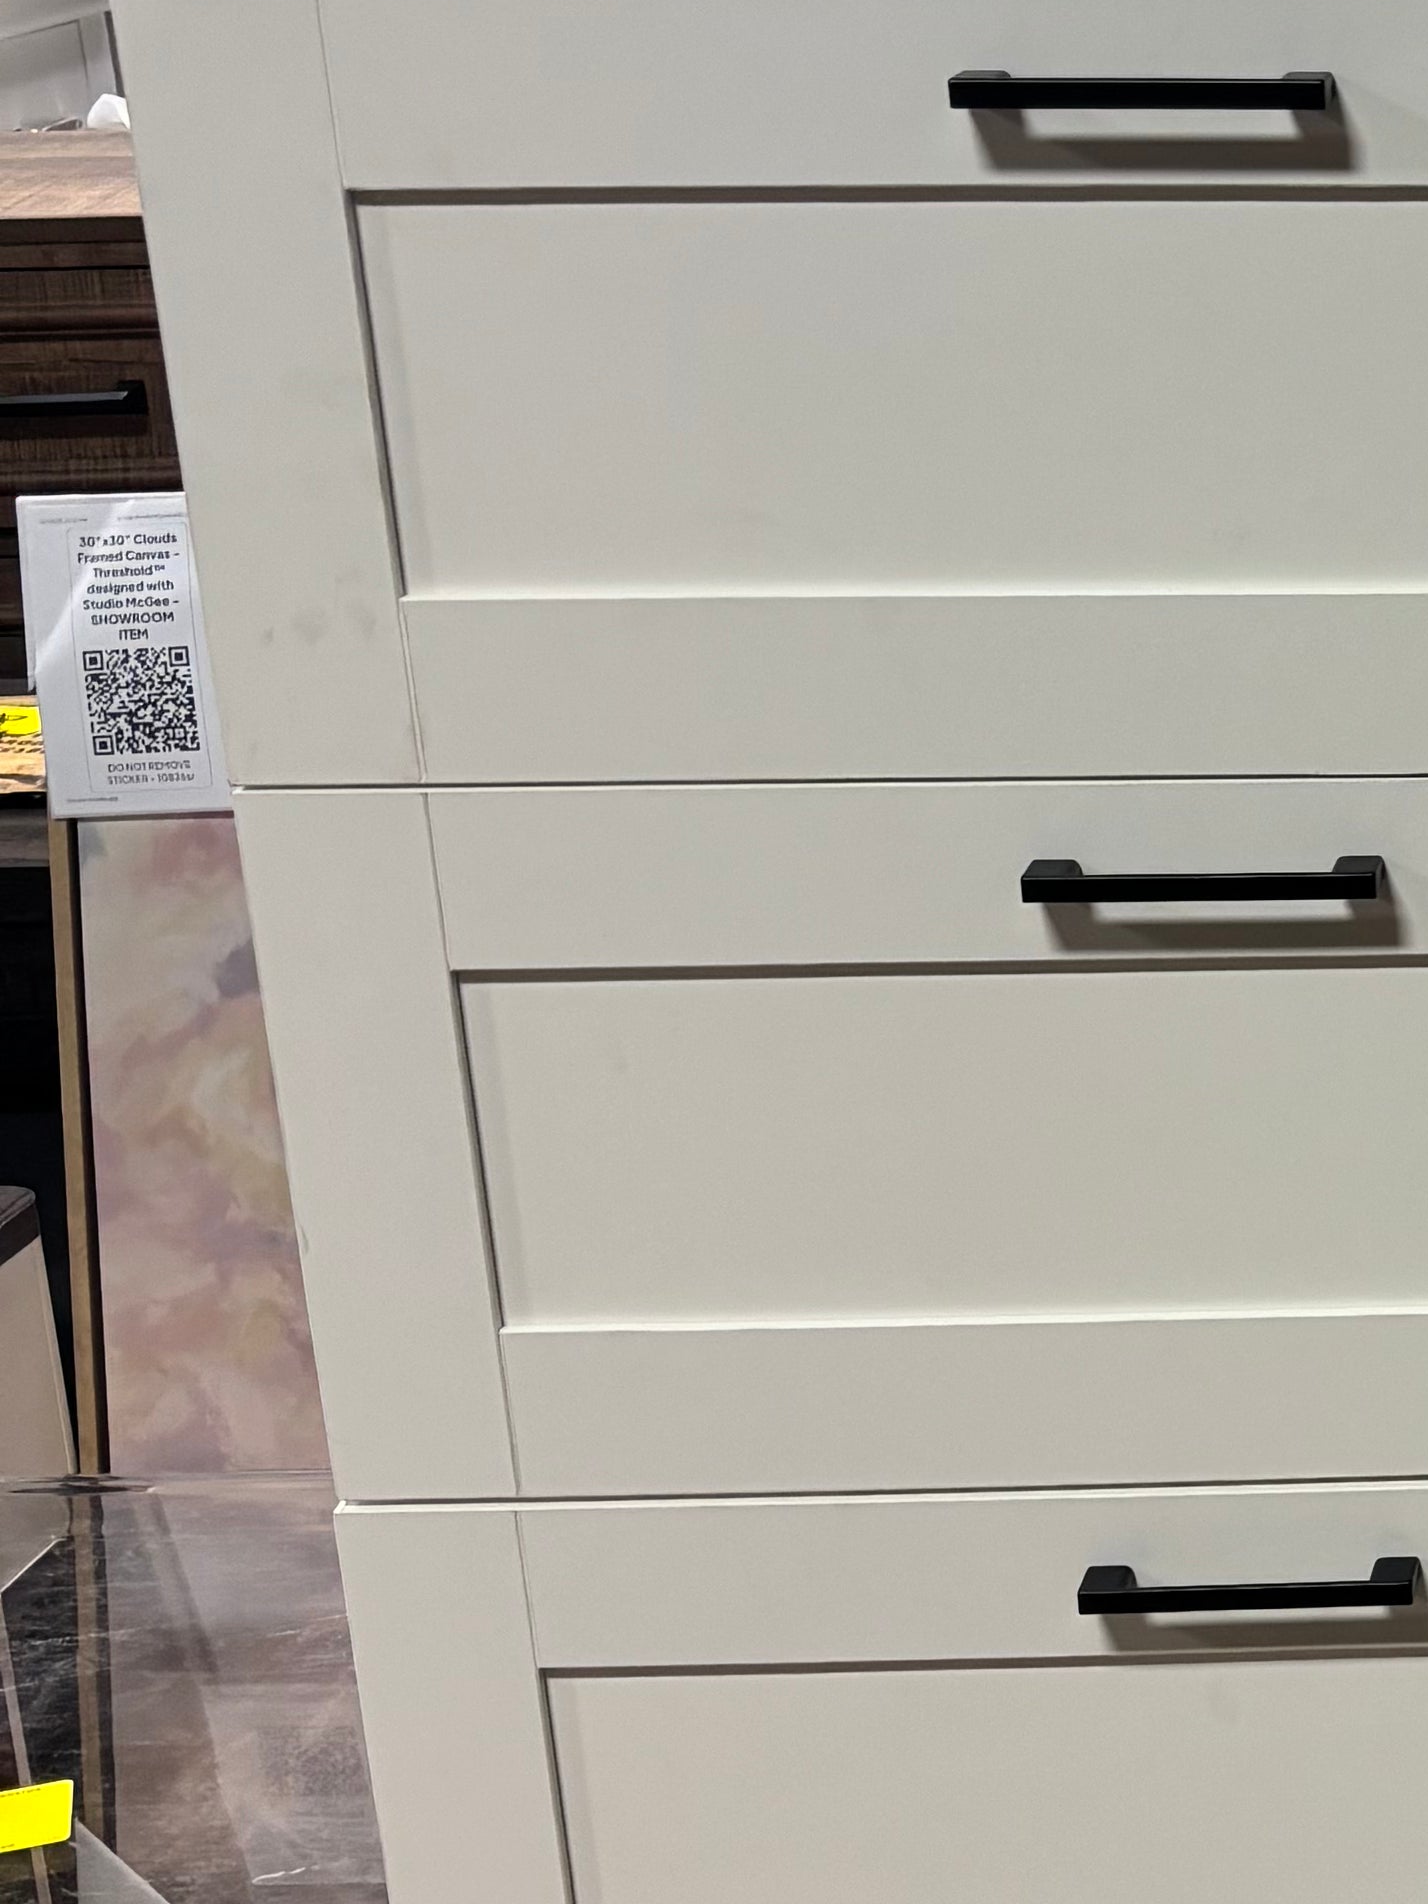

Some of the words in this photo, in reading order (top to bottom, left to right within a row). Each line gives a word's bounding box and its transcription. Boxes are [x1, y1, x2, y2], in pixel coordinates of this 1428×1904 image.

[133, 532, 178, 545] Clouds
[77, 551, 124, 564] Framed
[125, 550, 171, 561] Canvas
[87, 580, 144, 595] designed
[146, 580, 175, 591] with
[82, 598, 124, 610] Studio
[125, 596, 170, 608] McGee
[91, 611, 175, 625] SHOWROOM
[118, 628, 149, 641] ITEM
[107, 763, 123, 773] DO
[125, 761, 147, 772] NOT
[148, 759, 191, 771] REMOVE
[107, 774, 149, 785] STICKER
